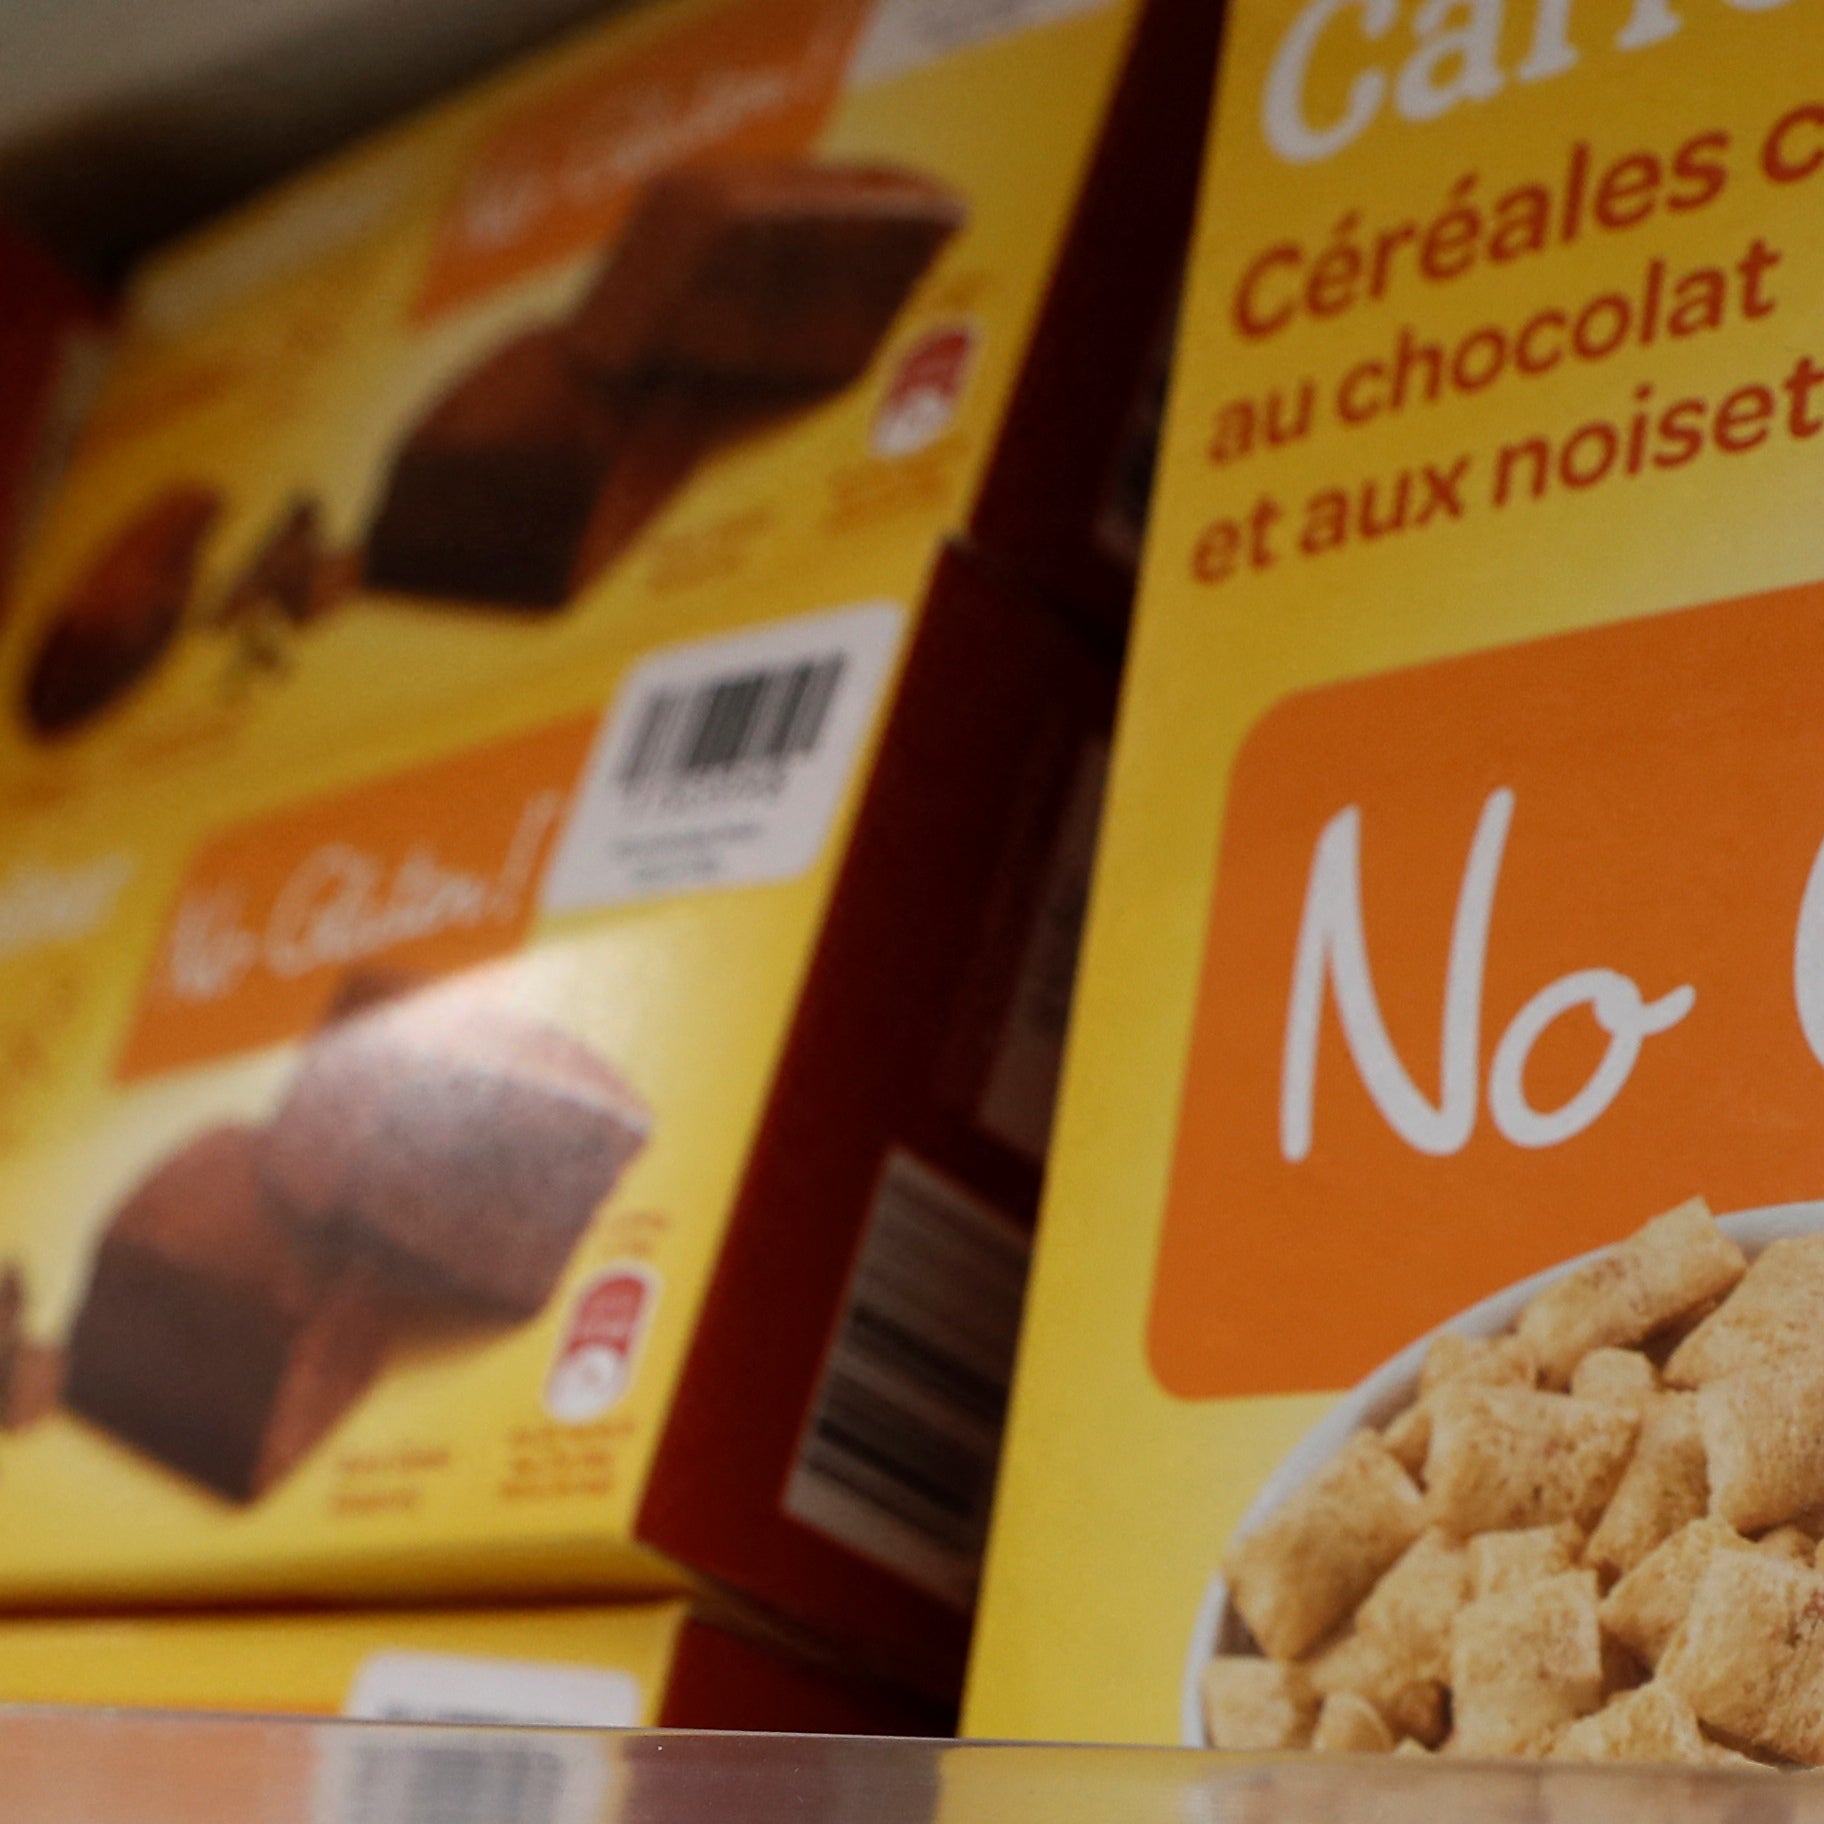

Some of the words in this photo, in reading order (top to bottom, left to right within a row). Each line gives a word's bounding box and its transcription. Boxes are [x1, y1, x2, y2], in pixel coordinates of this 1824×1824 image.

[1232, 130, 1731, 342] Céréales
[1205, 378, 1314, 466] au
[1336, 240, 1782, 426] chocolat
[1187, 492, 1282, 588] et
[1297, 454, 1470, 558] aux
[1279, 785, 1697, 1164] No
